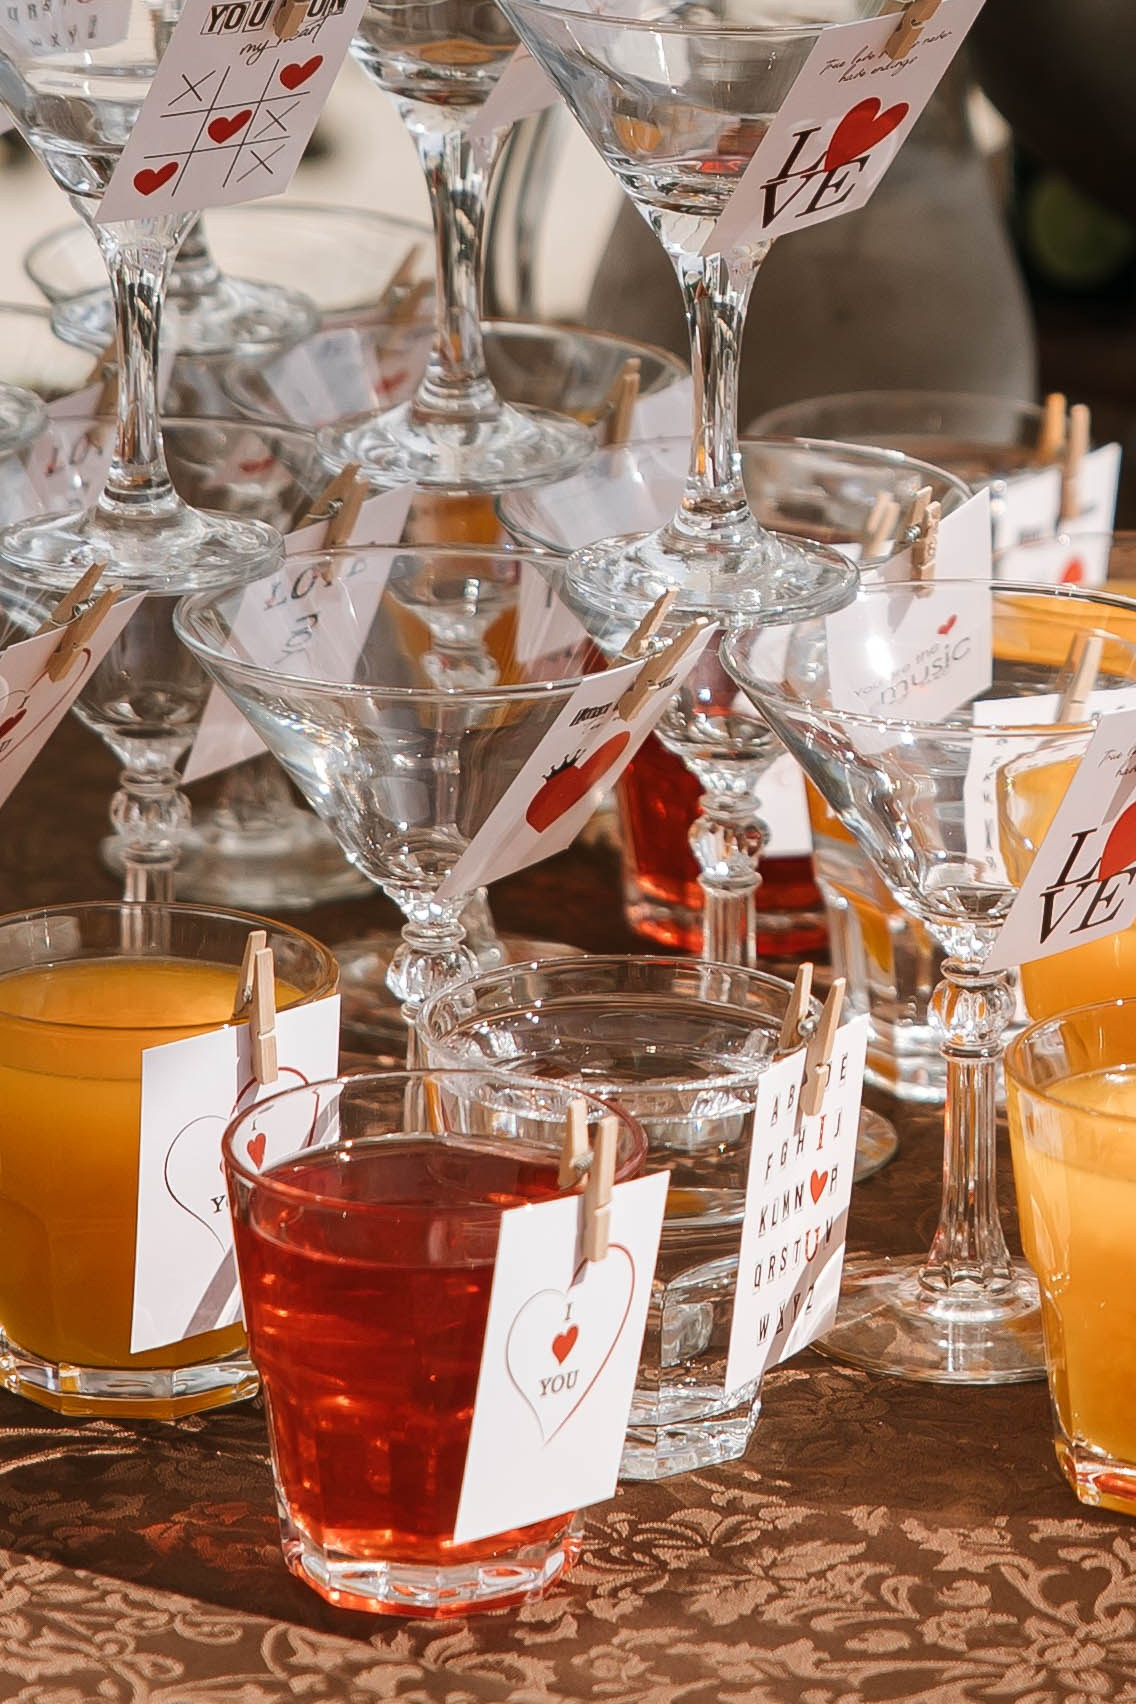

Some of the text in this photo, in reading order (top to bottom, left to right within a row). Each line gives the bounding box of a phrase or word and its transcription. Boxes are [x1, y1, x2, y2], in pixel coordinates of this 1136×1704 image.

[240, 40, 277, 66] my
[880, 636, 971, 705] music
[539, 1369, 579, 1396] YOU
